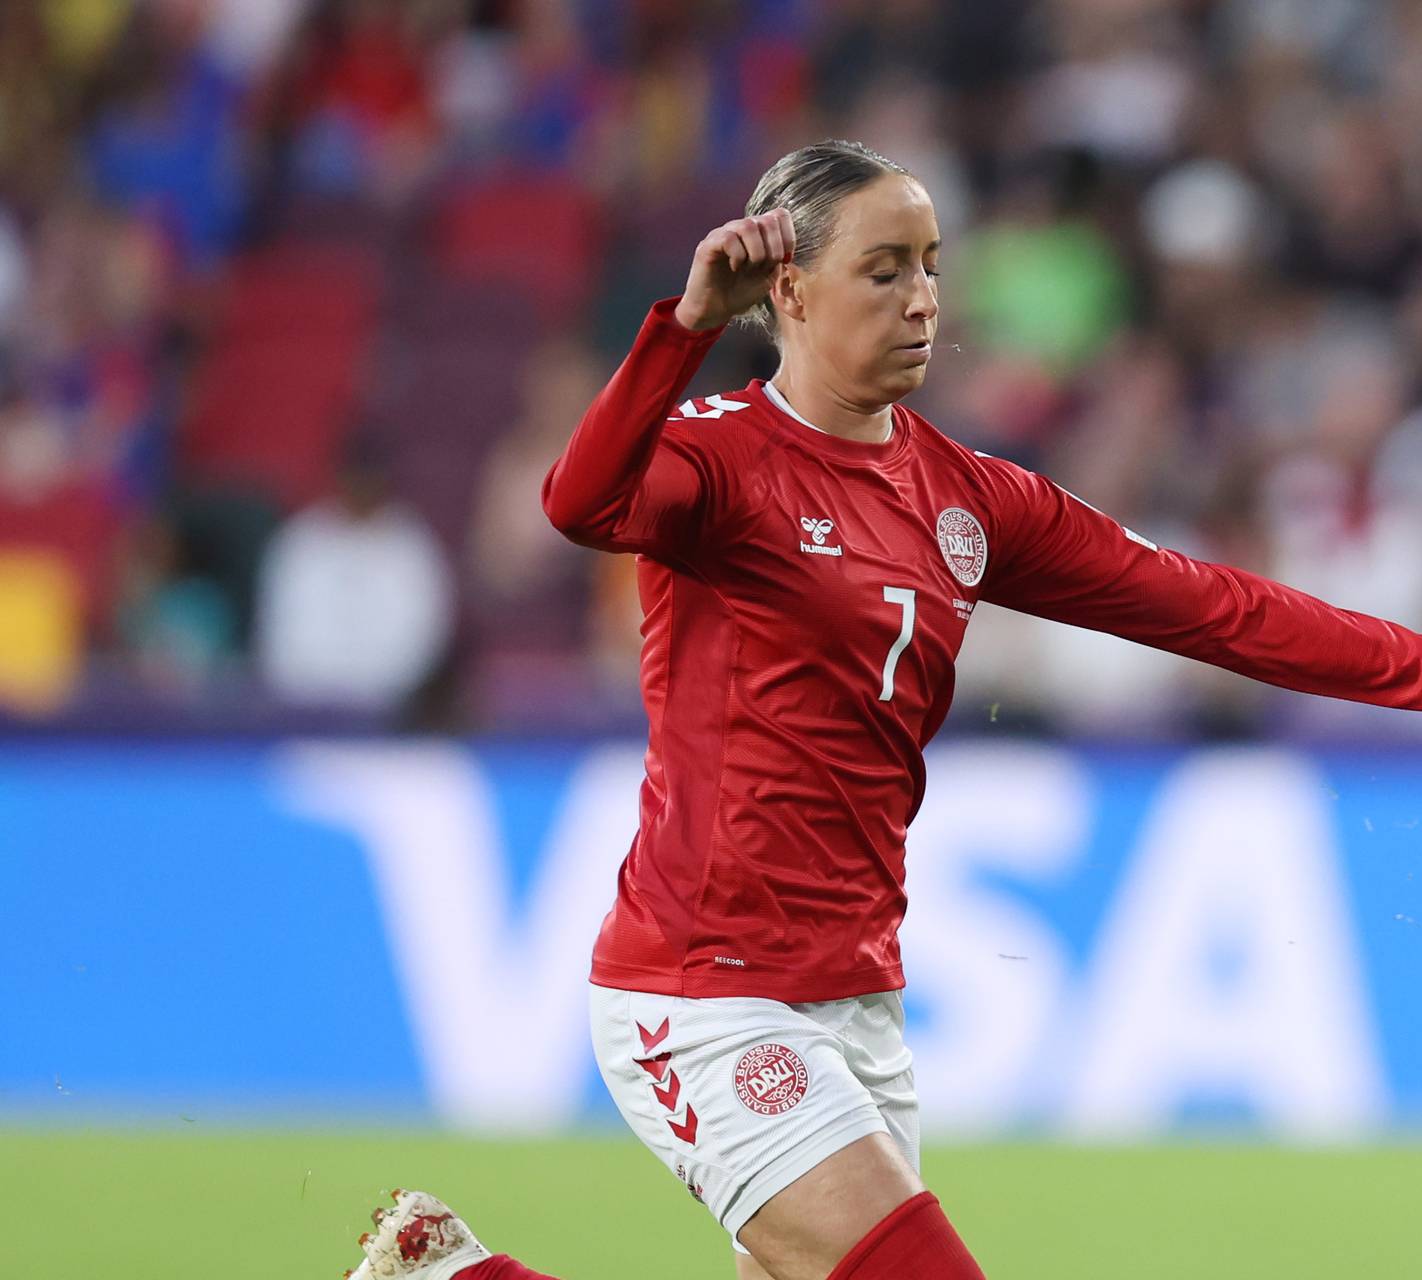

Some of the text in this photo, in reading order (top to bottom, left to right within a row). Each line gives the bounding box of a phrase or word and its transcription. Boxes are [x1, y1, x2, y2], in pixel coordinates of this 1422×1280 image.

[800, 540, 842, 556] hummel
[946, 535, 975, 556] DBU
[879, 586, 916, 701] 7
[275, 750, 1390, 1138] VSA
[747, 1059, 794, 1098] DBU
[785, 1051, 807, 1088] UNION
[736, 1081, 770, 1114] DANSK
[776, 1091, 803, 1113] 1889
